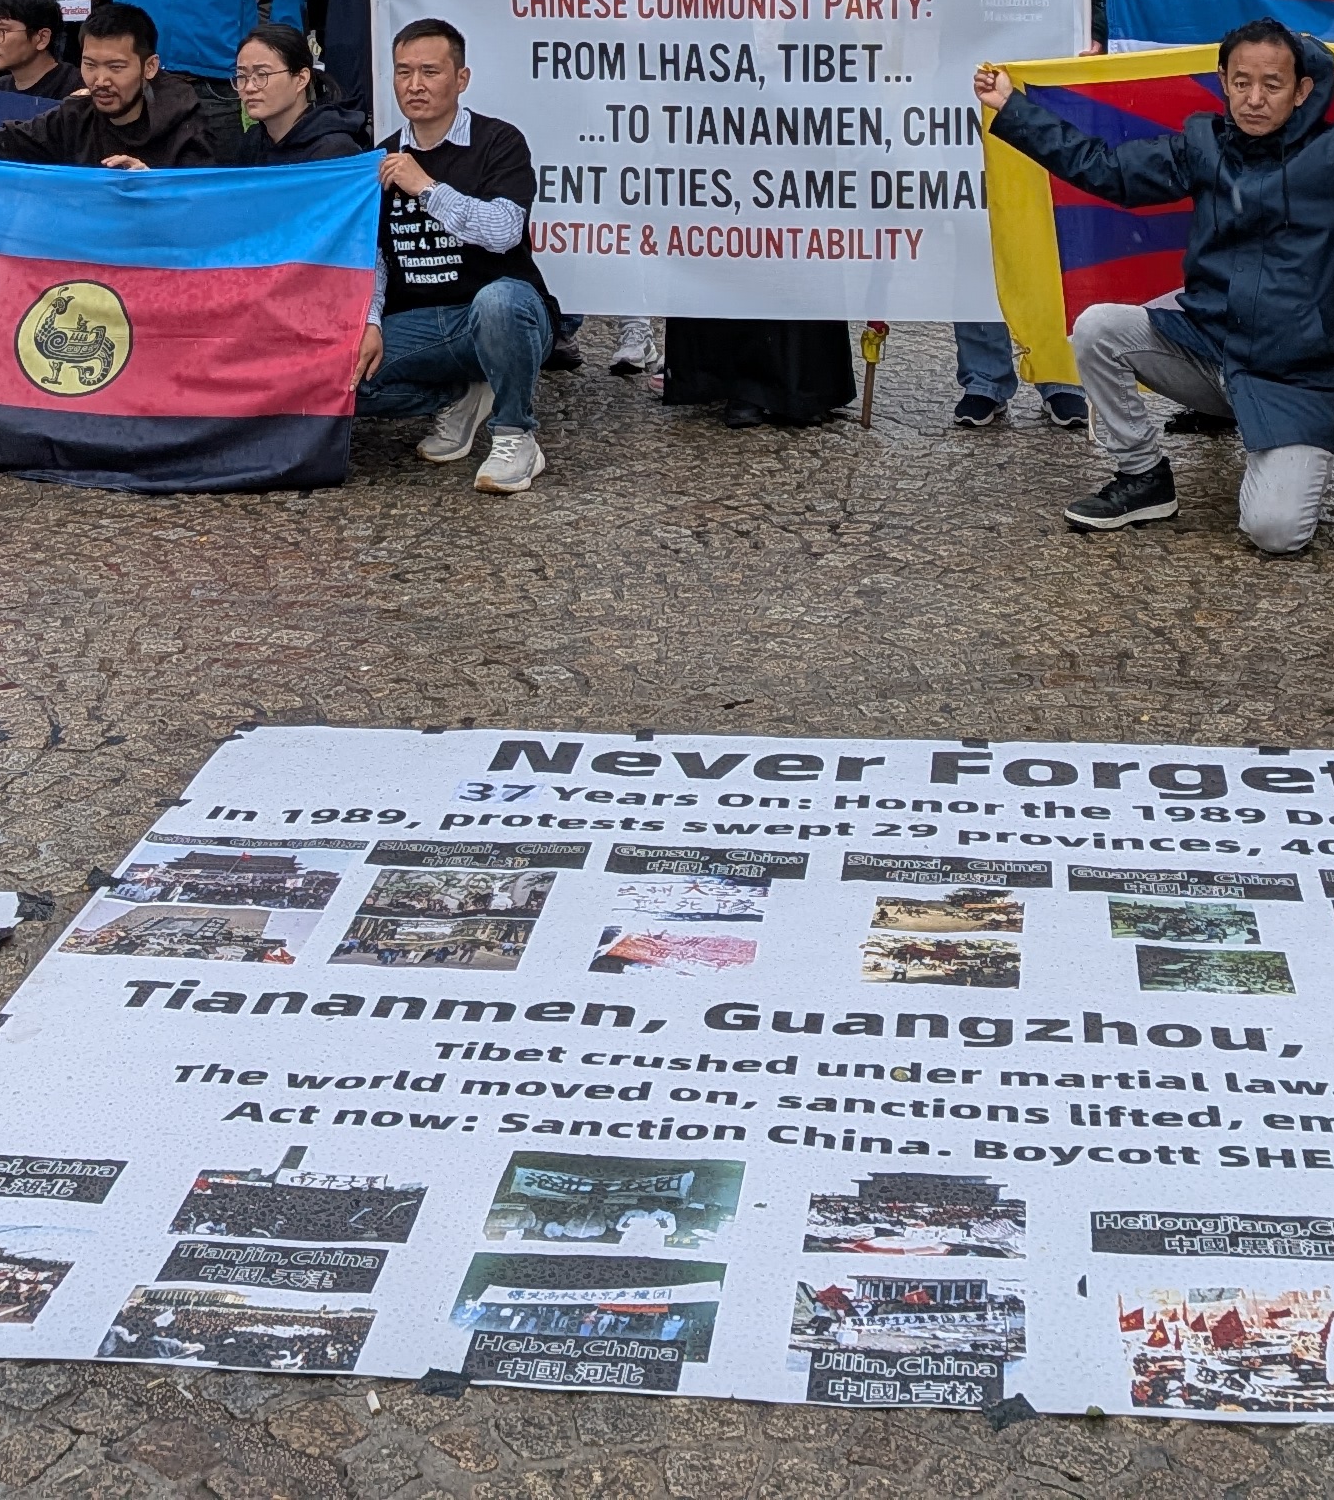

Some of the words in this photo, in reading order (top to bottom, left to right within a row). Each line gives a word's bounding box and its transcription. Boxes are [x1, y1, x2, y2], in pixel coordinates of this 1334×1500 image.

[532, 41, 626, 80] FROM
[639, 43, 766, 89] LHASA,
[778, 44, 913, 84] TIBET...
[578, 104, 650, 145] ...TO
[662, 106, 891, 152] TIANANMEN,
[620, 167, 741, 215] CITIES,
[752, 169, 857, 210] SAME
[390, 222, 421, 234] Never
[393, 239, 415, 252] June
[418, 237, 430, 250] 4,
[640, 225, 659, 257] &
[667, 226, 924, 261] ACCOUNTABILITY
[398, 254, 463, 267] Tiananmen
[405, 270, 458, 283] Massacre
[487, 740, 885, 781] Never
[459, 783, 536, 802] 37
[552, 787, 698, 806] Years
[718, 794, 811, 809] On:
[834, 795, 1004, 815] Honor
[1021, 801, 1111, 819] the
[1132, 806, 1265, 823] 1989
[206, 806, 258, 821] In
[282, 808, 421, 829] 1989,
[439, 814, 664, 831] protests
[683, 822, 855, 840] swept
[872, 823, 937, 837] 29
[959, 830, 1261, 856] provinces,
[124, 980, 667, 1033] Tiananmen,
[704, 1002, 1303, 1058] Guangzhou,
[435, 1042, 567, 1063] Tibet
[581, 1053, 798, 1075] crushed
[818, 1062, 982, 1084] under
[1001, 1070, 1209, 1091] martial
[175, 1064, 268, 1085] The
[288, 1070, 446, 1092] world
[461, 1080, 652, 1101] moved
[670, 1088, 757, 1109] on,
[777, 1096, 1049, 1124] sanctions
[1070, 1104, 1242, 1130] lifted,
[221, 1102, 320, 1124] Act
[333, 1110, 478, 1131] now:
[498, 1113, 746, 1140] Sanction
[768, 1126, 951, 1156] China.
[975, 1140, 1200, 1166] Boycott
[178, 1241, 380, 1270] Tianjin,China
[475, 1334, 680, 1363] Hebei,China
[814, 1352, 998, 1378] Jilin,China
